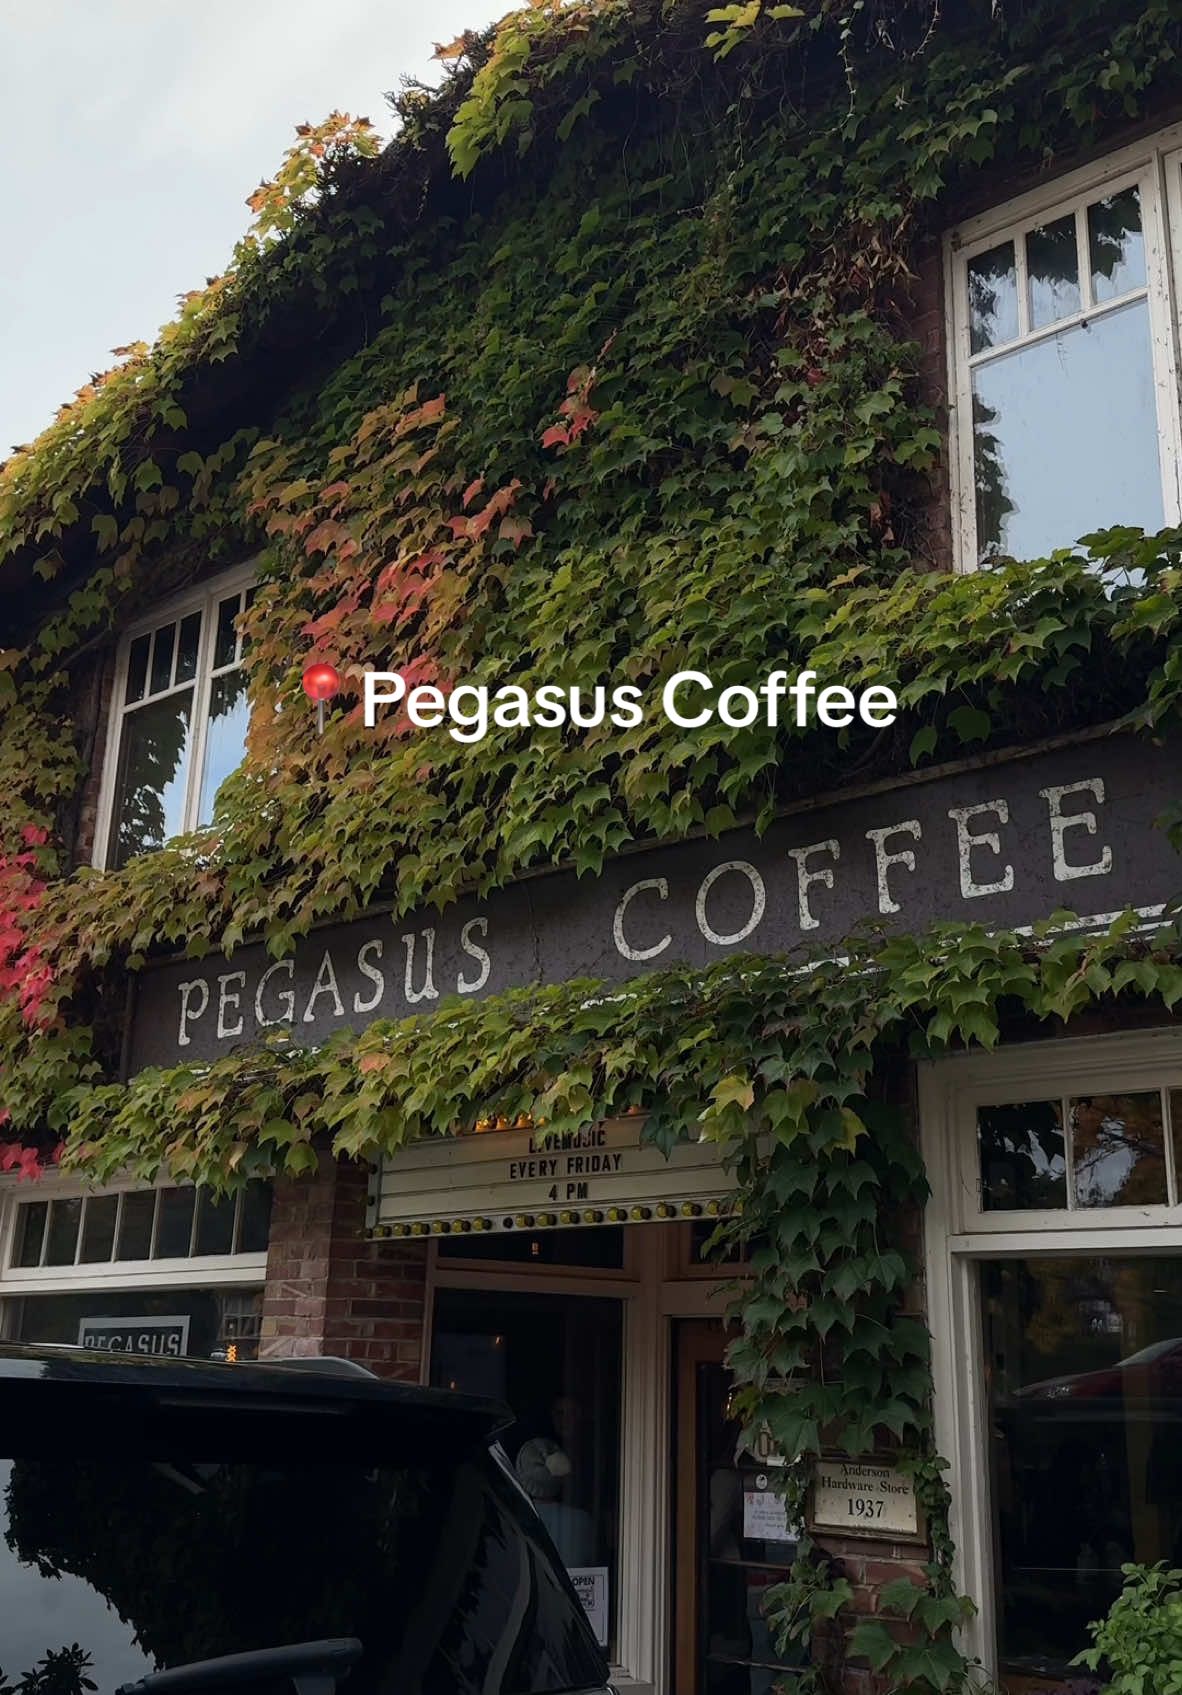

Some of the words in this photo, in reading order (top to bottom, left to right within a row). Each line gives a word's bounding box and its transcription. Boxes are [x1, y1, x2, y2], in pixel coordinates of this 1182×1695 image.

[178, 917, 491, 1046] PEGASUS
[613, 778, 1112, 961] COFFEE
[510, 1160, 557, 1179] EVERY
[567, 1153, 622, 1174] FRIDAY
[548, 1184, 557, 1200] 4
[567, 1182, 588, 1200] PM
[841, 1464, 890, 1478] Anderson
[822, 1476, 873, 1491] Hardware
[880, 1481, 909, 1494] Store
[848, 1498, 884, 1518] 1937
